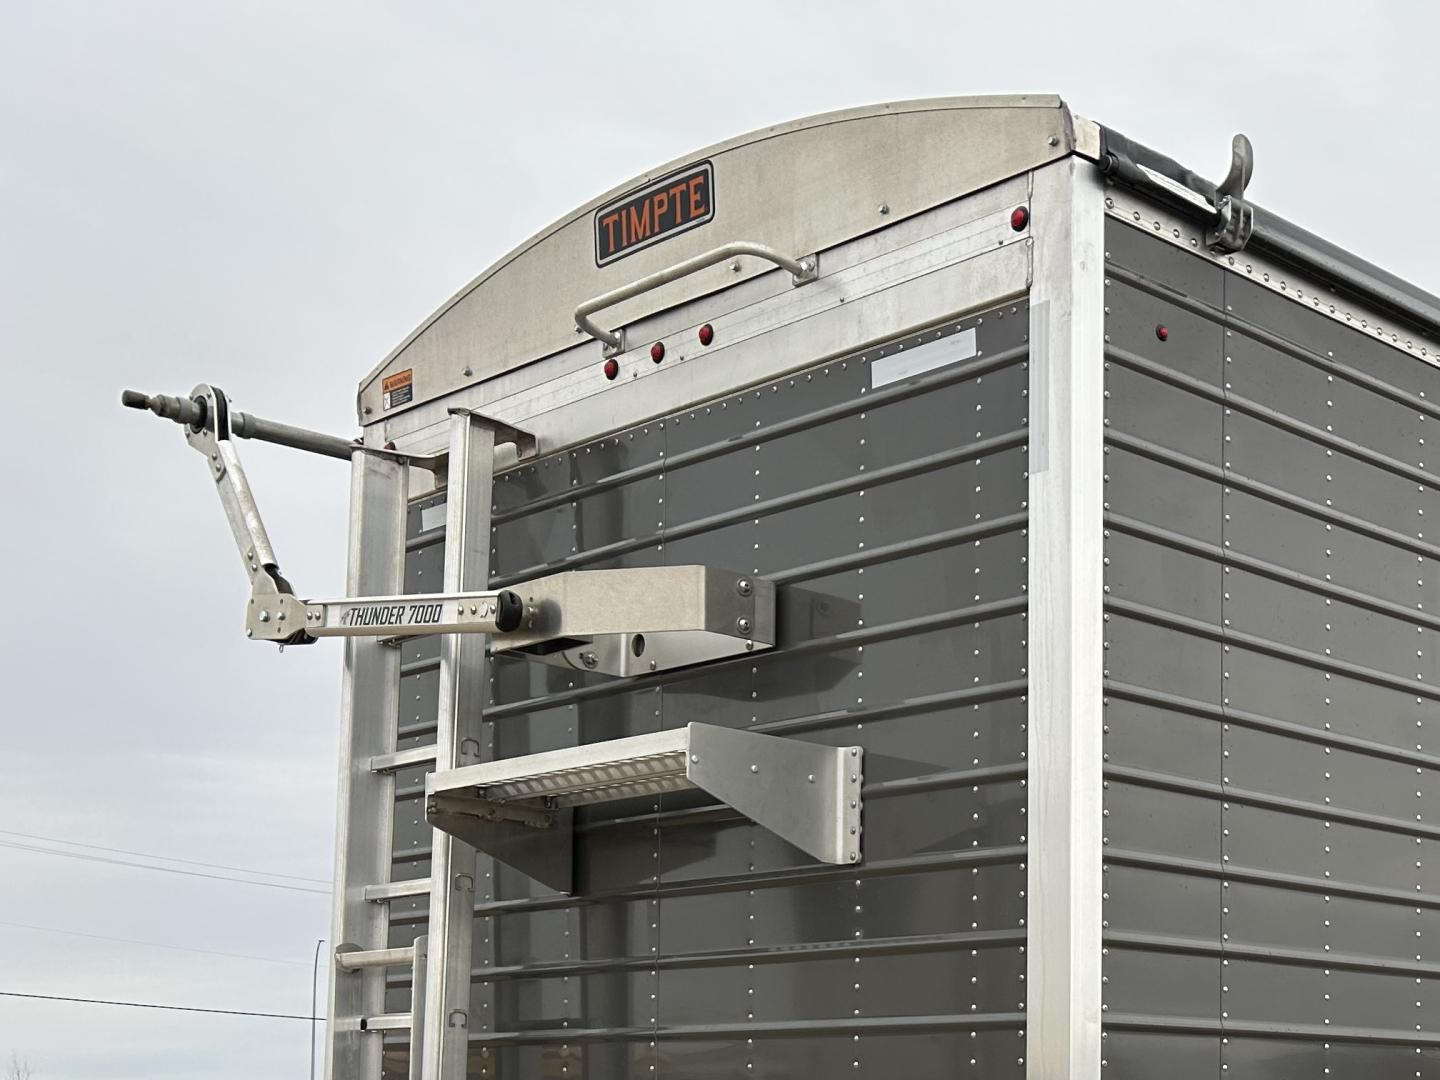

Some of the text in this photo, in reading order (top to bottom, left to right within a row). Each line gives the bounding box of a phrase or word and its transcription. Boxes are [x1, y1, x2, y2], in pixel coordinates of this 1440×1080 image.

[602, 176, 705, 252] TIMPTE
[349, 604, 442, 626] THUNDER 7000
